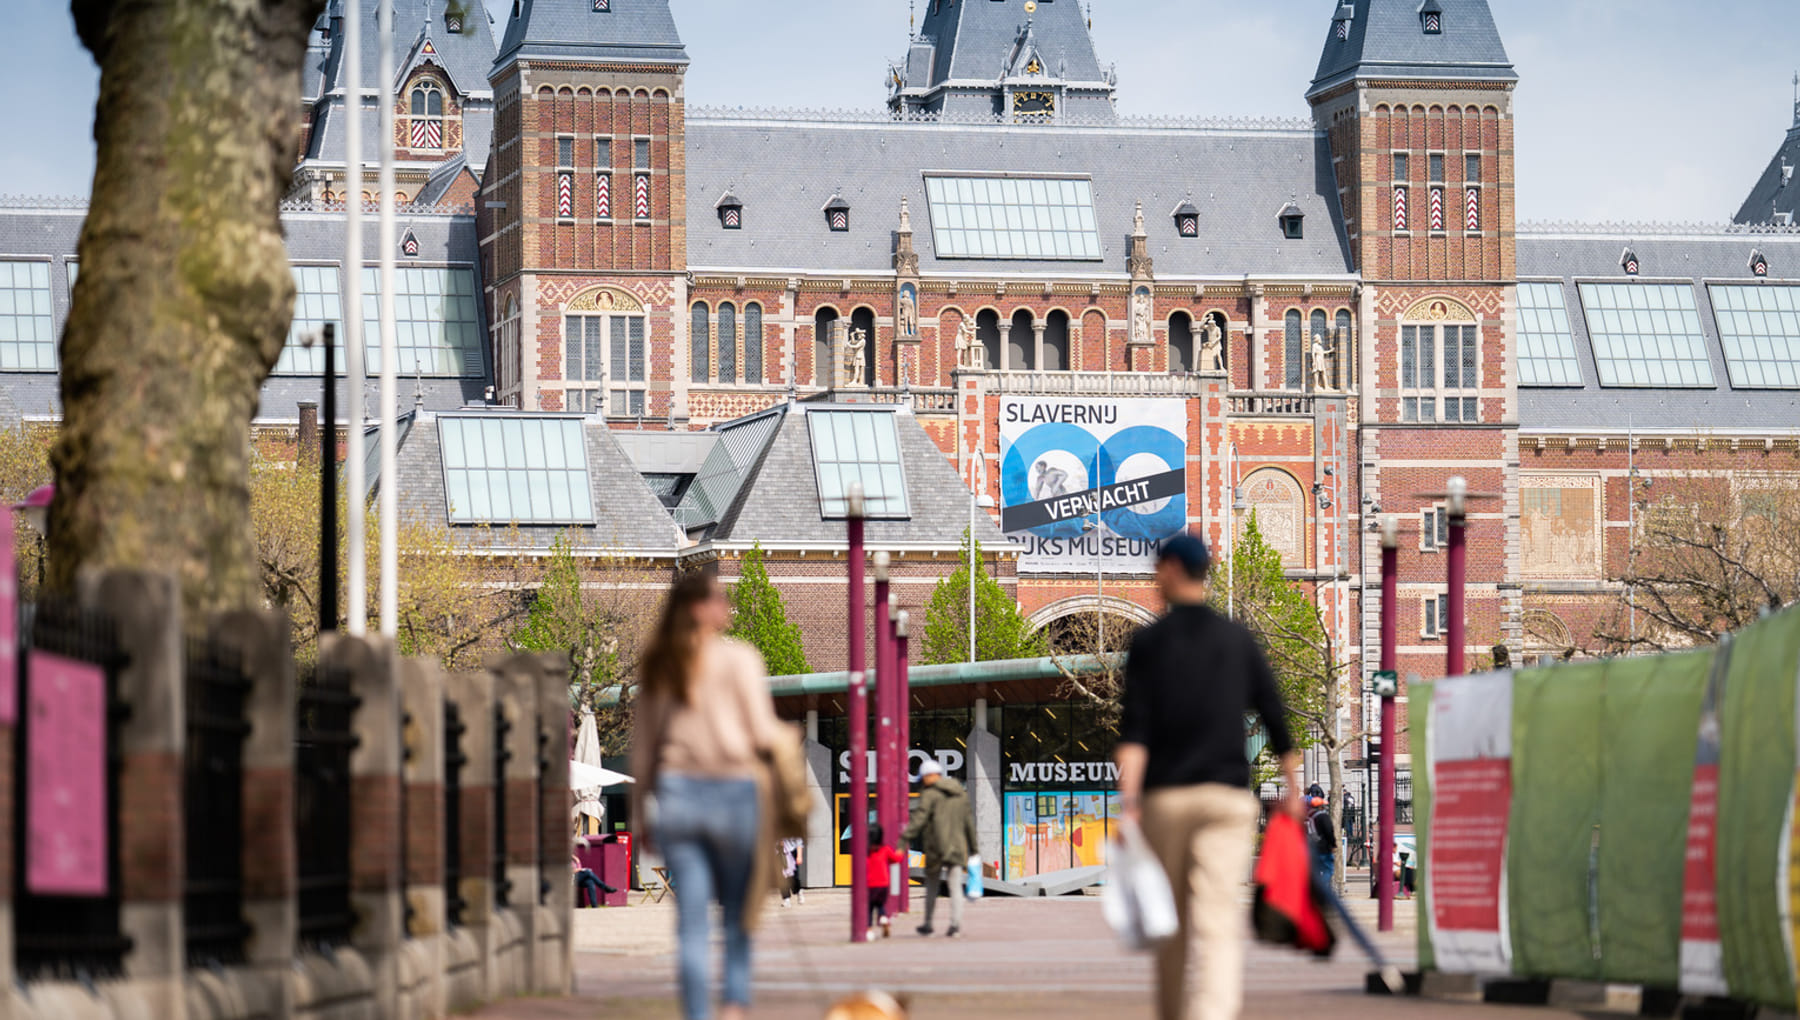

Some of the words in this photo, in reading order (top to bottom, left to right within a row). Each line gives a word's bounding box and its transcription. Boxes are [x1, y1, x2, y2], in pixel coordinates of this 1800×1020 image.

[1006, 402, 1117, 424] SLAVERNIJ
[1044, 480, 1150, 520] VERWACHT
[1068, 536, 1161, 557] MUSEUM
